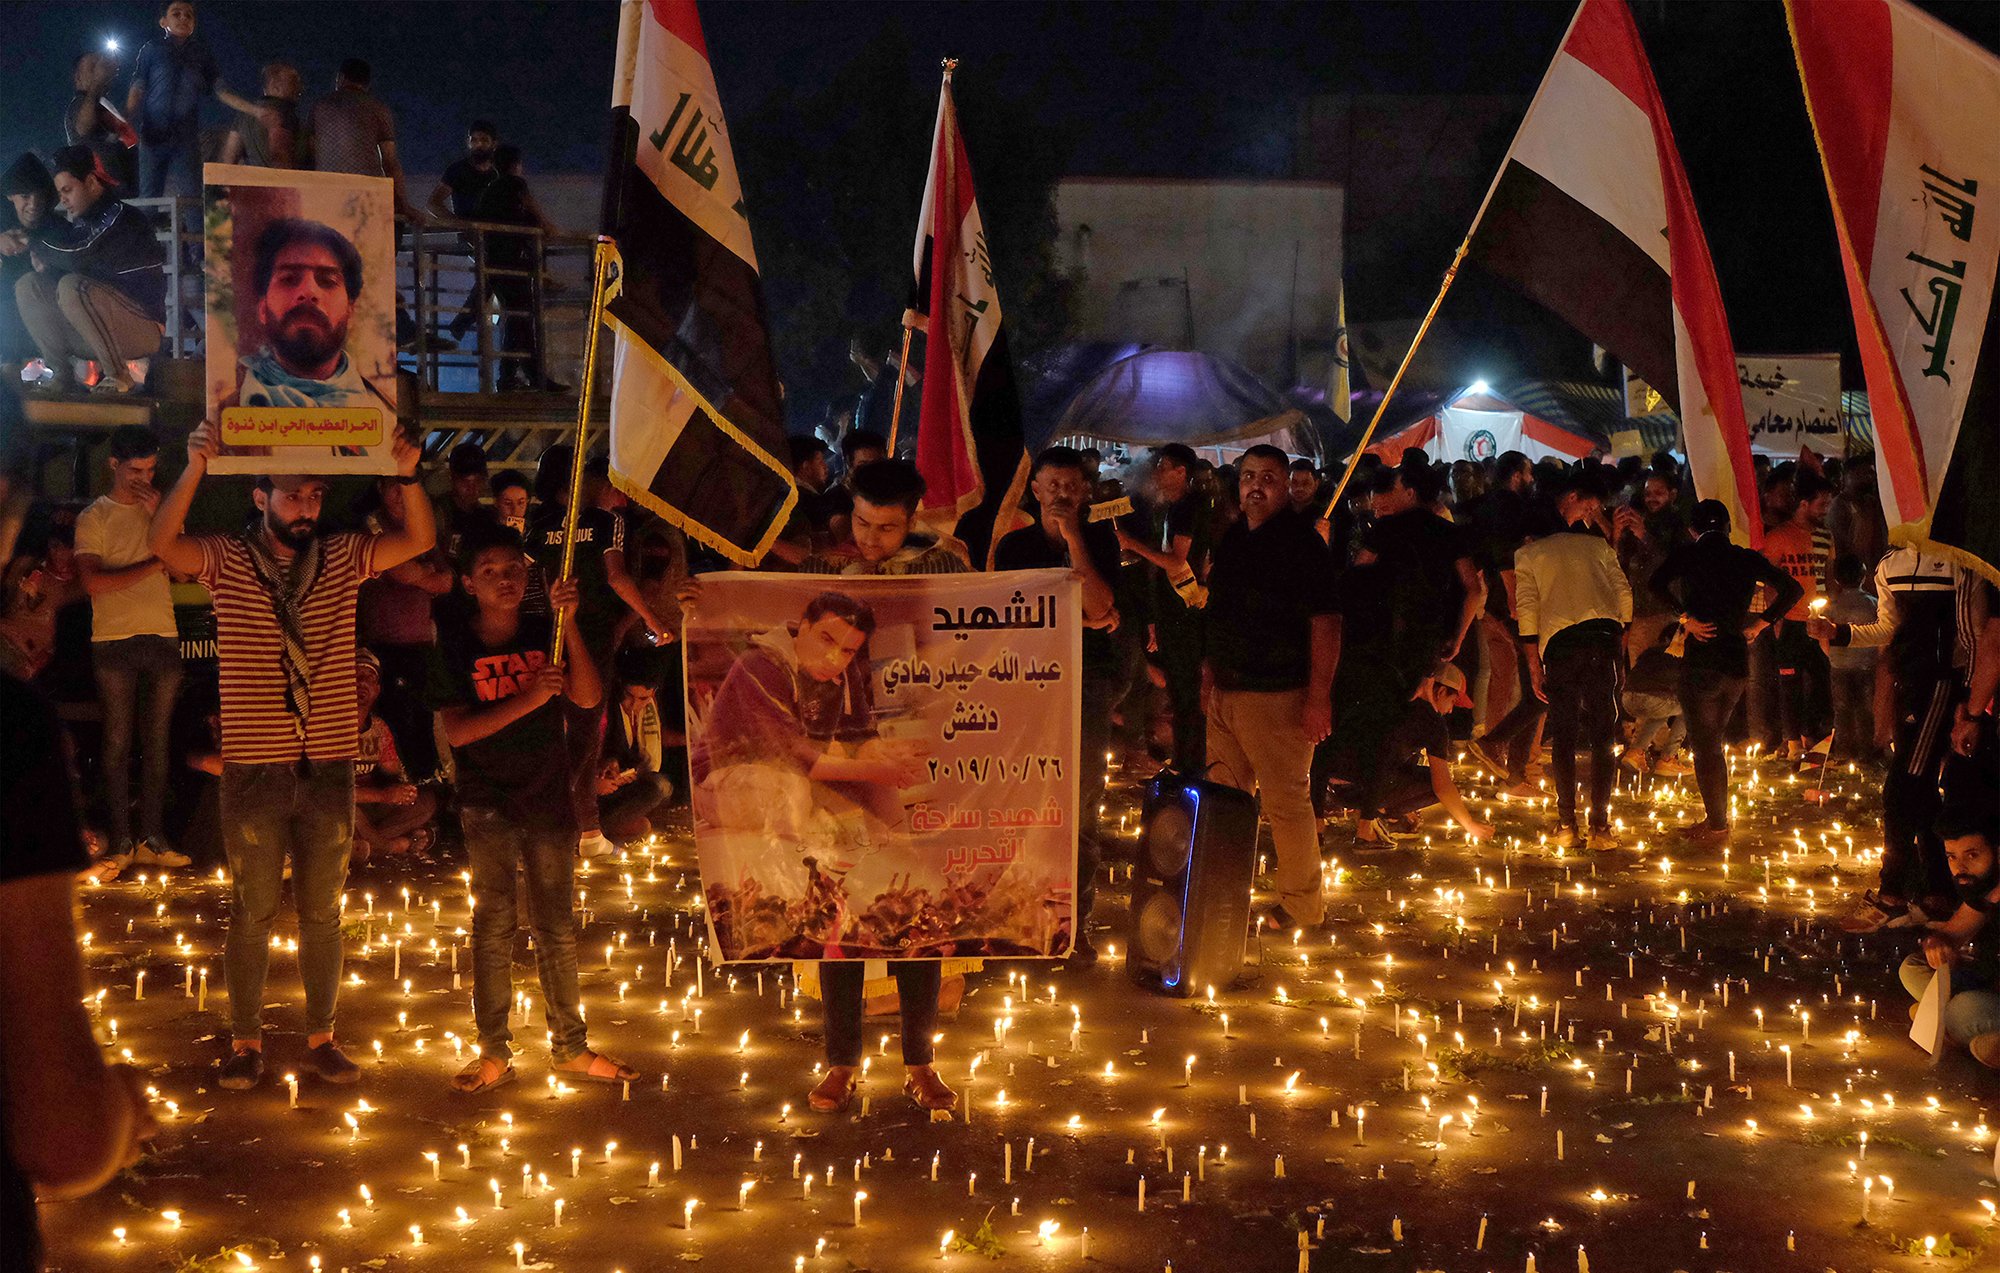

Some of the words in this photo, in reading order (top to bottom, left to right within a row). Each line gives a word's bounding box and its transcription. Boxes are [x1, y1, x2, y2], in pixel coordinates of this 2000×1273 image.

[1912, 163, 1978, 242] الله
[258, 418, 278, 434] ابن
[307, 418, 348, 435] العظيم
[348, 418, 378, 433] الحر
[1795, 407, 1842, 442] اعتصام
[932, 590, 1056, 641] الشهيد
[471, 650, 544, 680] STAR
[884, 656, 931, 695] هادي
[933, 658, 983, 691] حيدر
[987, 650, 1019, 682] الله
[1024, 658, 1062, 690] عبد
[943, 701, 999, 741] دنفش
[911, 802, 982, 832] ساحة
[987, 795, 1064, 836] شهيد
[941, 836, 1026, 876] التحرير
